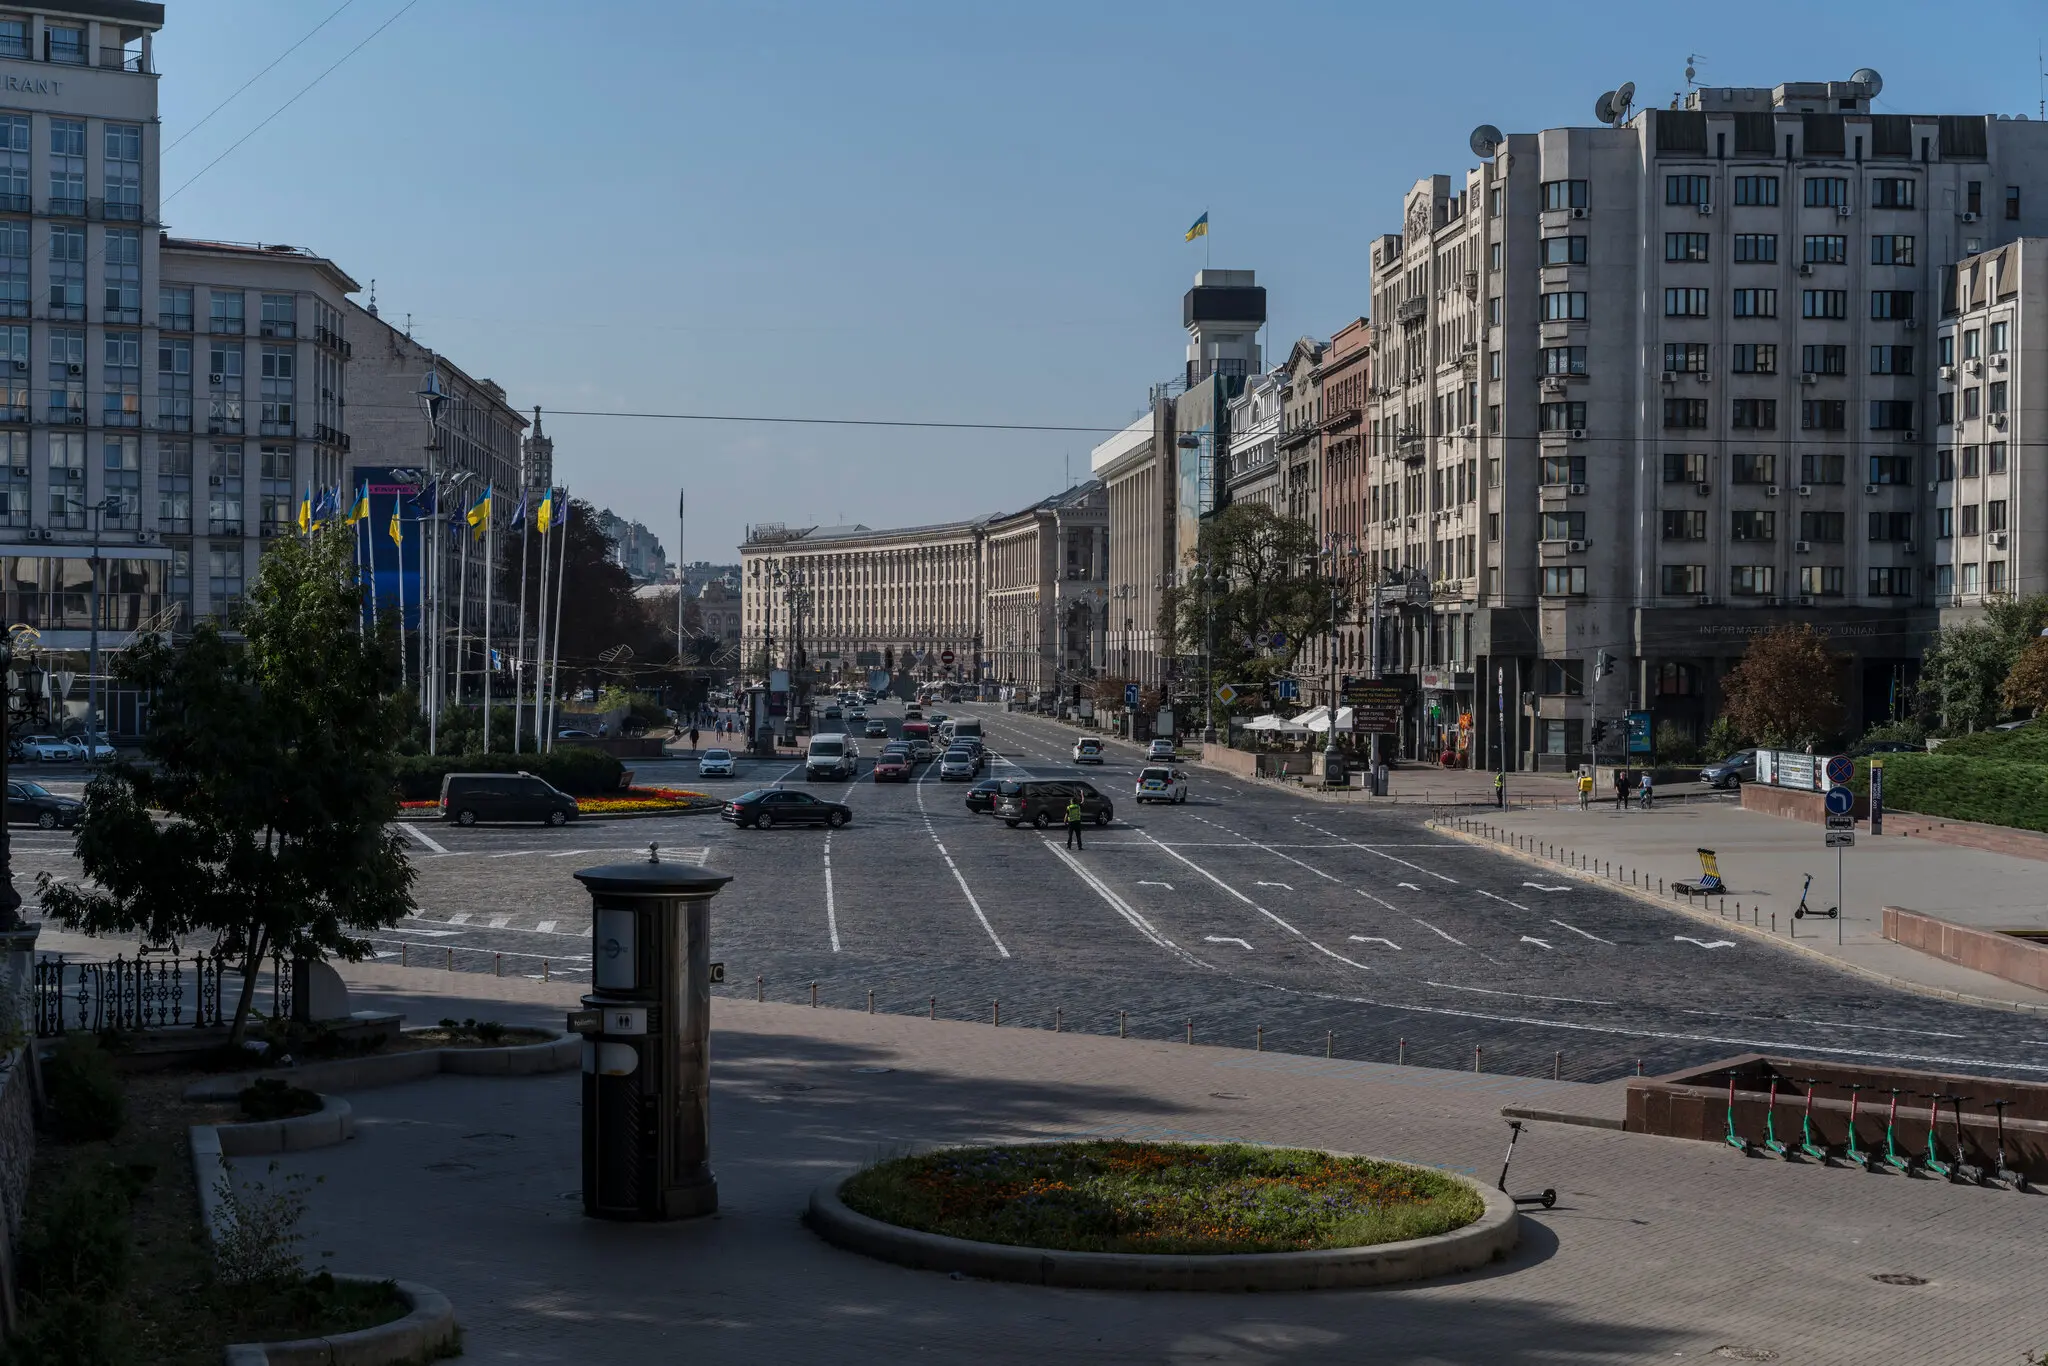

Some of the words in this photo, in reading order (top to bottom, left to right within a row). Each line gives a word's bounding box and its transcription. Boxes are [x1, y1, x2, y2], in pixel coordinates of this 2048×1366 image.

[0, 75, 63, 95] RANT
[1700, 625, 1776, 635] INFORMATIO
[1841, 626, 1876, 636] UNIAN
